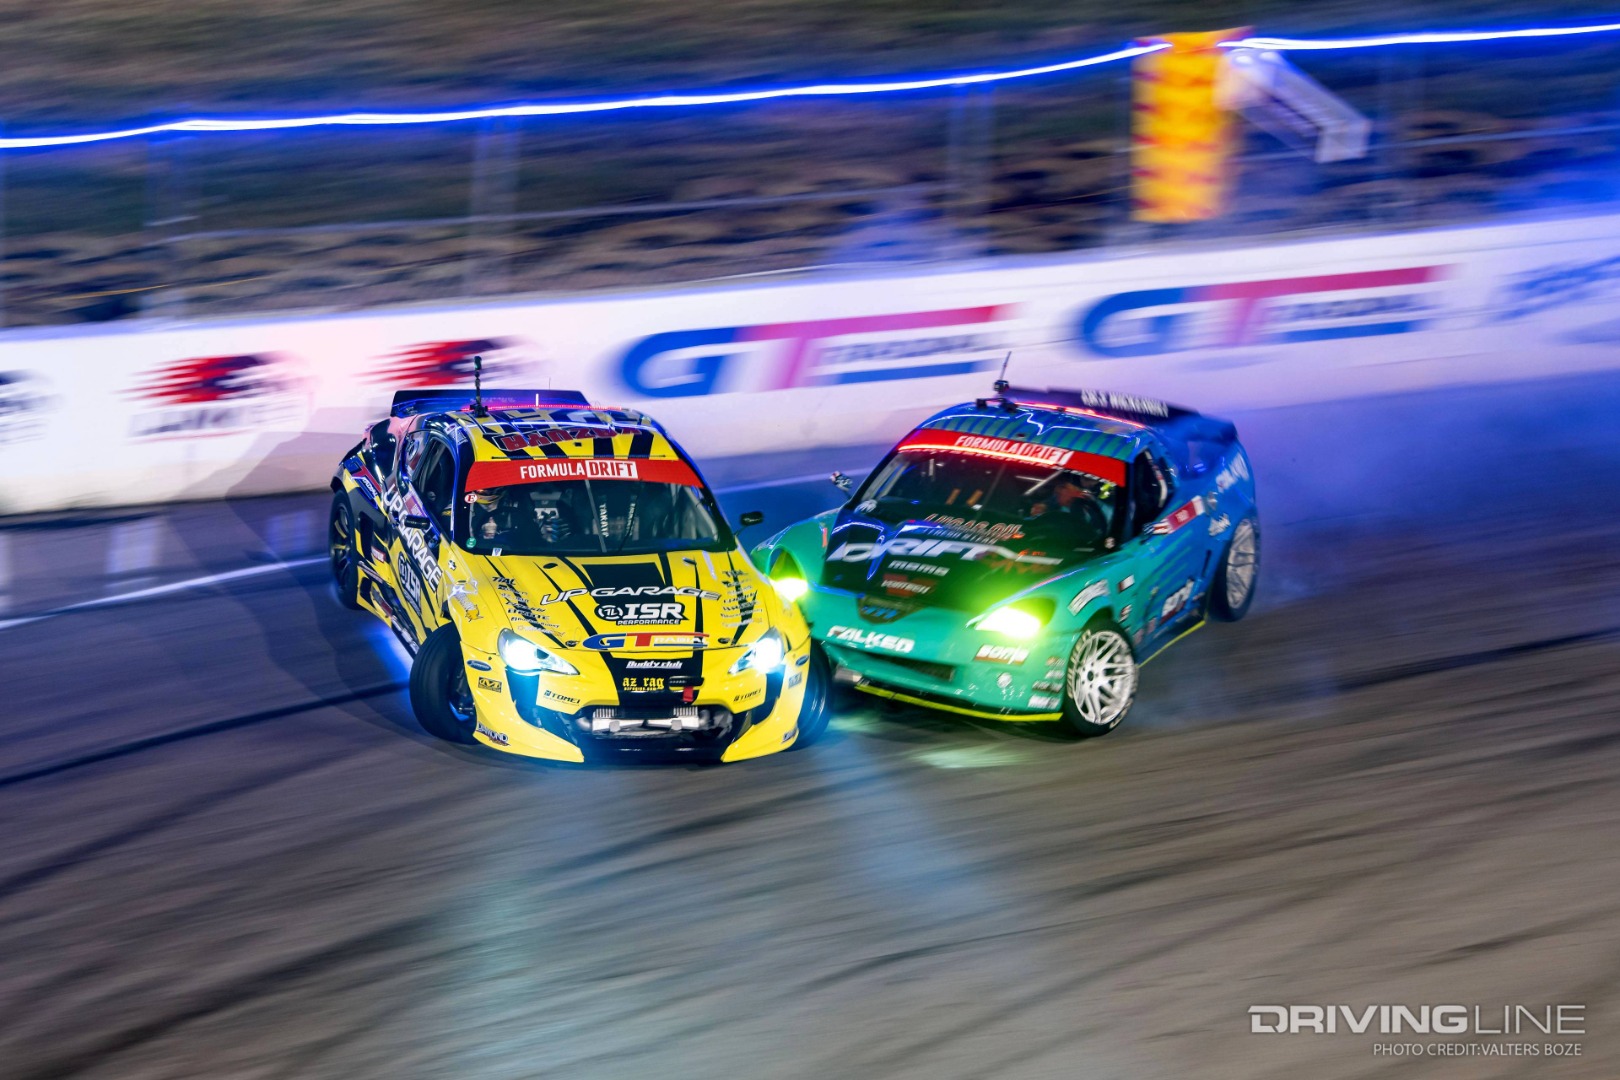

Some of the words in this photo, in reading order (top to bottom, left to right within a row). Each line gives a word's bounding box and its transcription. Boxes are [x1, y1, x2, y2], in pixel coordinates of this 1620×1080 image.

[954, 434, 1020, 456] FORMULA
[520, 463, 585, 479] FORMULA
[587, 461, 637, 479] DRIFT
[383, 483, 404, 515] UP
[540, 588, 590, 605] UP
[590, 586, 721, 601] GARAGE
[623, 603, 683, 620] ISR
[622, 677, 637, 687] az
[643, 677, 664, 690] rag
[551, 691, 581, 704] TOMEI
